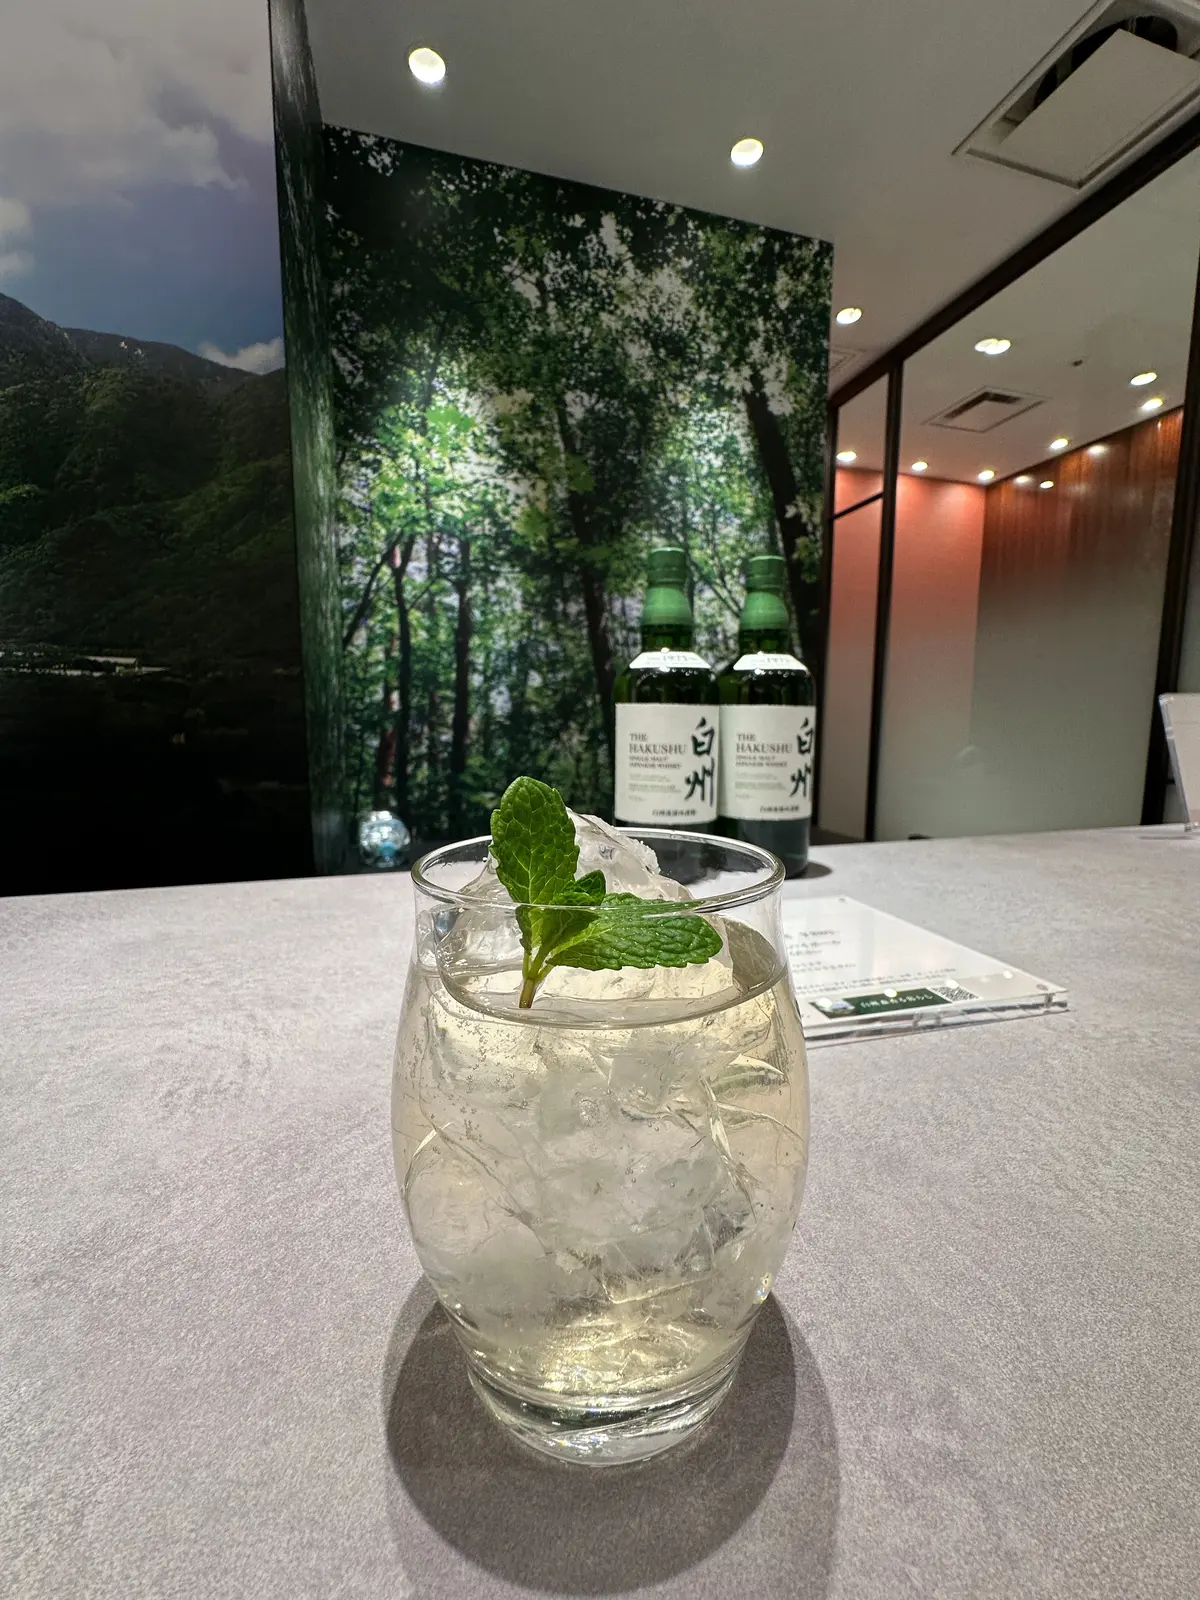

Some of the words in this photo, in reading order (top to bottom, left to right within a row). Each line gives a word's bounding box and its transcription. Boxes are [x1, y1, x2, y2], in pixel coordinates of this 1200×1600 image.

[629, 733, 648, 742] THE
[736, 733, 756, 742] THE
[629, 743, 687, 755] HAKUSHU
[736, 743, 793, 754] HAKUSHU
[684, 716, 715, 807] 白州
[789, 717, 814, 798] 白州
